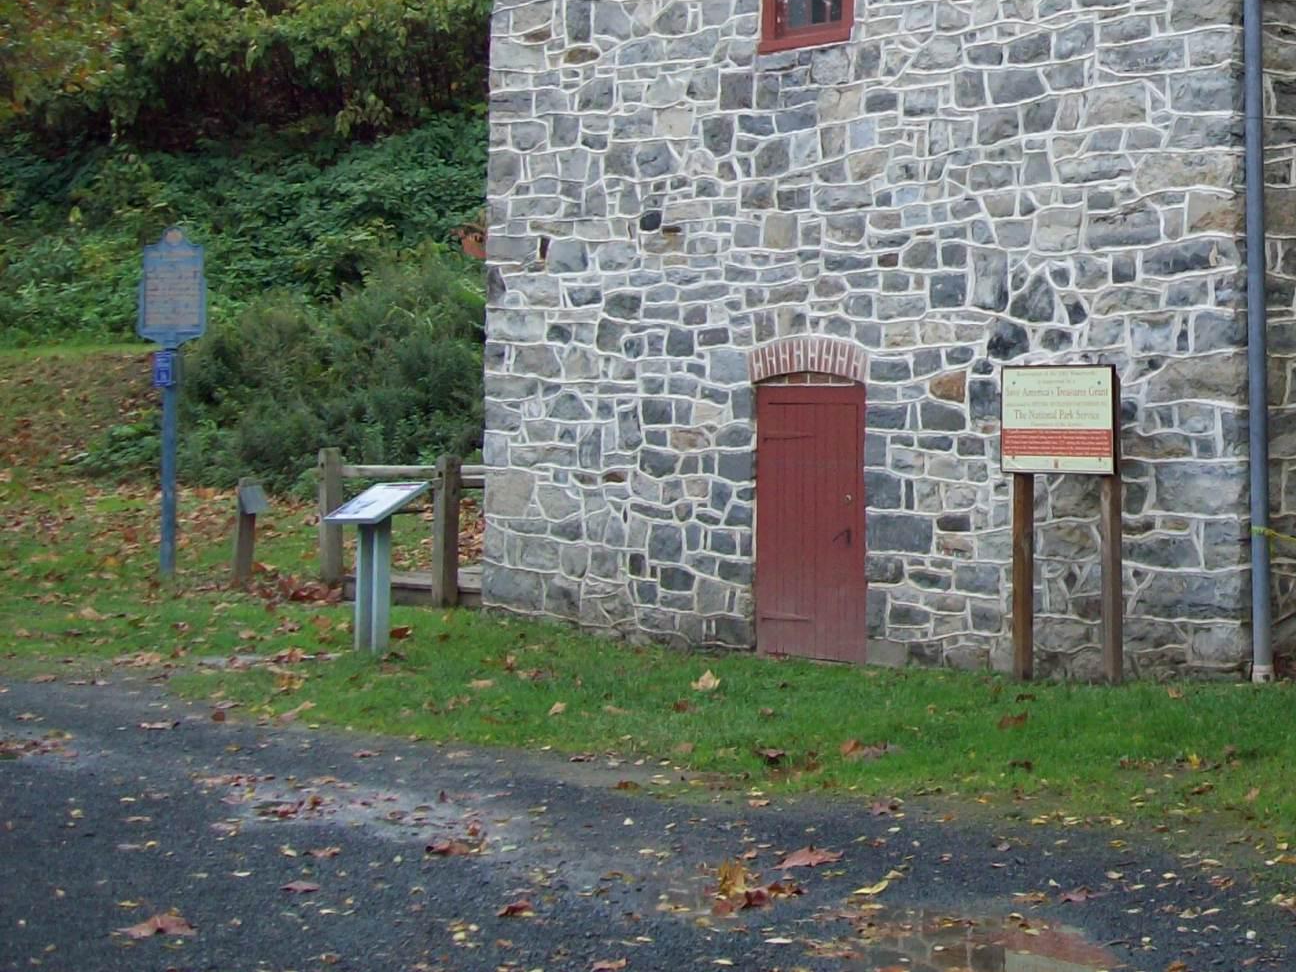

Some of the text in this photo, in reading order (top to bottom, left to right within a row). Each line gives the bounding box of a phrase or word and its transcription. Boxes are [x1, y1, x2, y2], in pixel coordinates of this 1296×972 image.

[1088, 387, 1108, 397] Grant
[1014, 409, 1026, 420] The
[1028, 409, 1057, 420] National
[1059, 409, 1075, 420] Park
